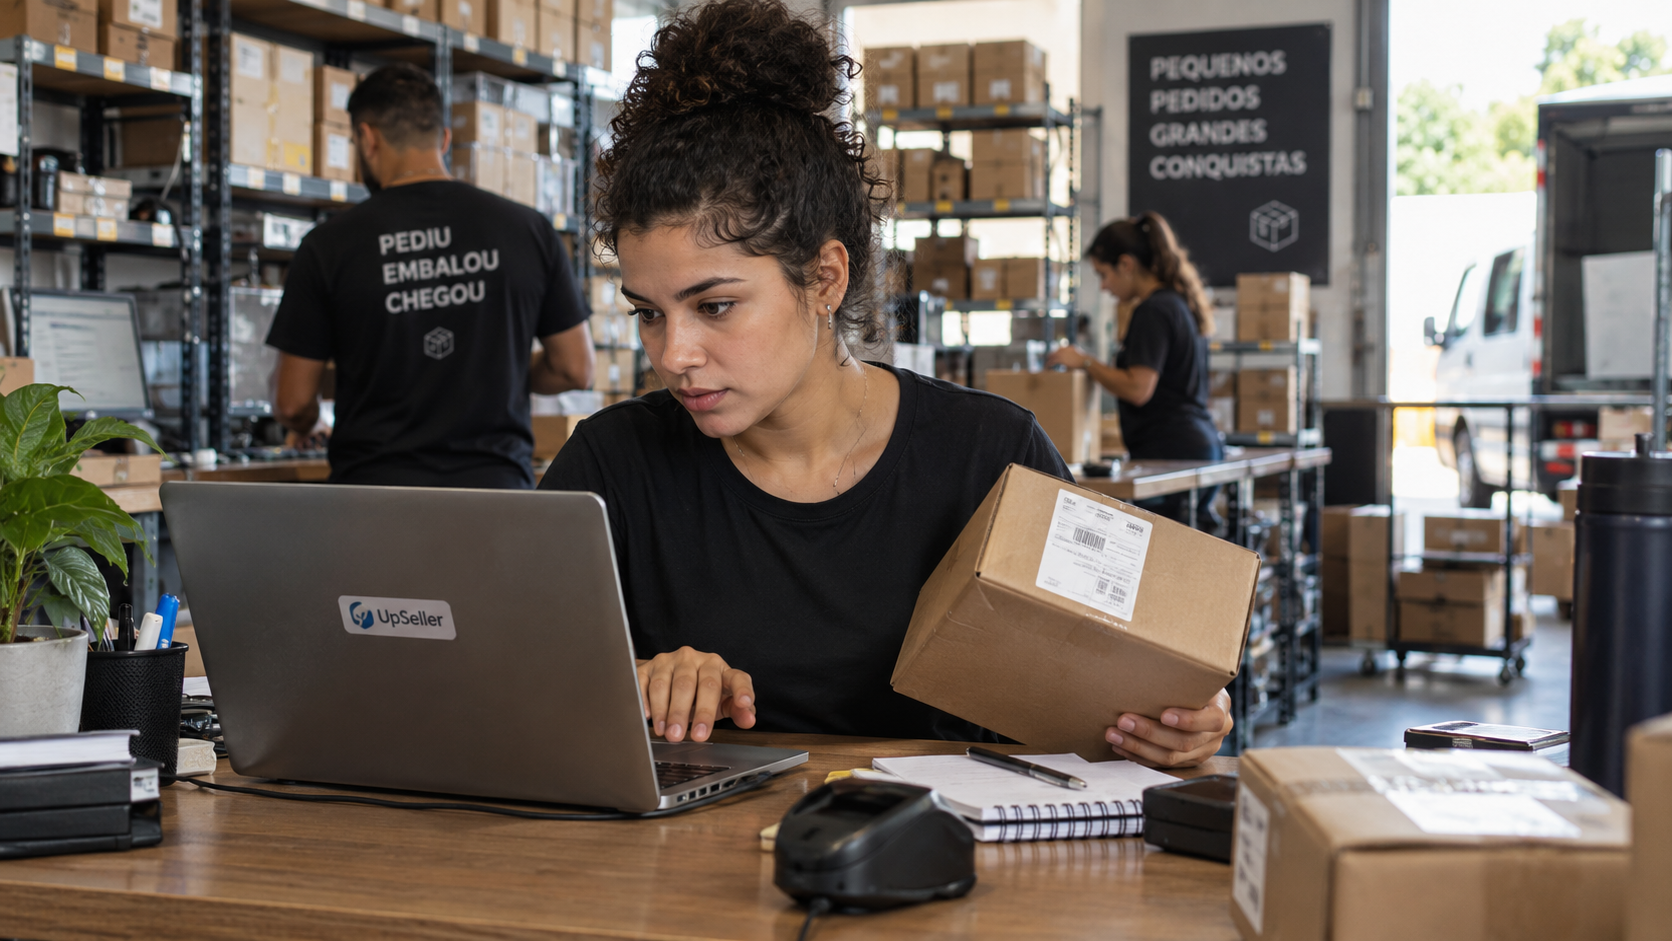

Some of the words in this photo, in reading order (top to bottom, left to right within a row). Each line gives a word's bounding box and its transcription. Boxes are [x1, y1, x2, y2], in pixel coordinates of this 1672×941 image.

[1150, 50, 1286, 81] PEQUENOS
[1150, 85, 1261, 114] PEDIDOS
[1149, 119, 1267, 147] GRANDES
[1149, 150, 1307, 181] CONQUISTAS
[379, 226, 452, 255] PEDIU
[382, 249, 499, 285] EMBALOU
[385, 280, 485, 314] CHEGOU
[377, 608, 444, 628] UpSeller
